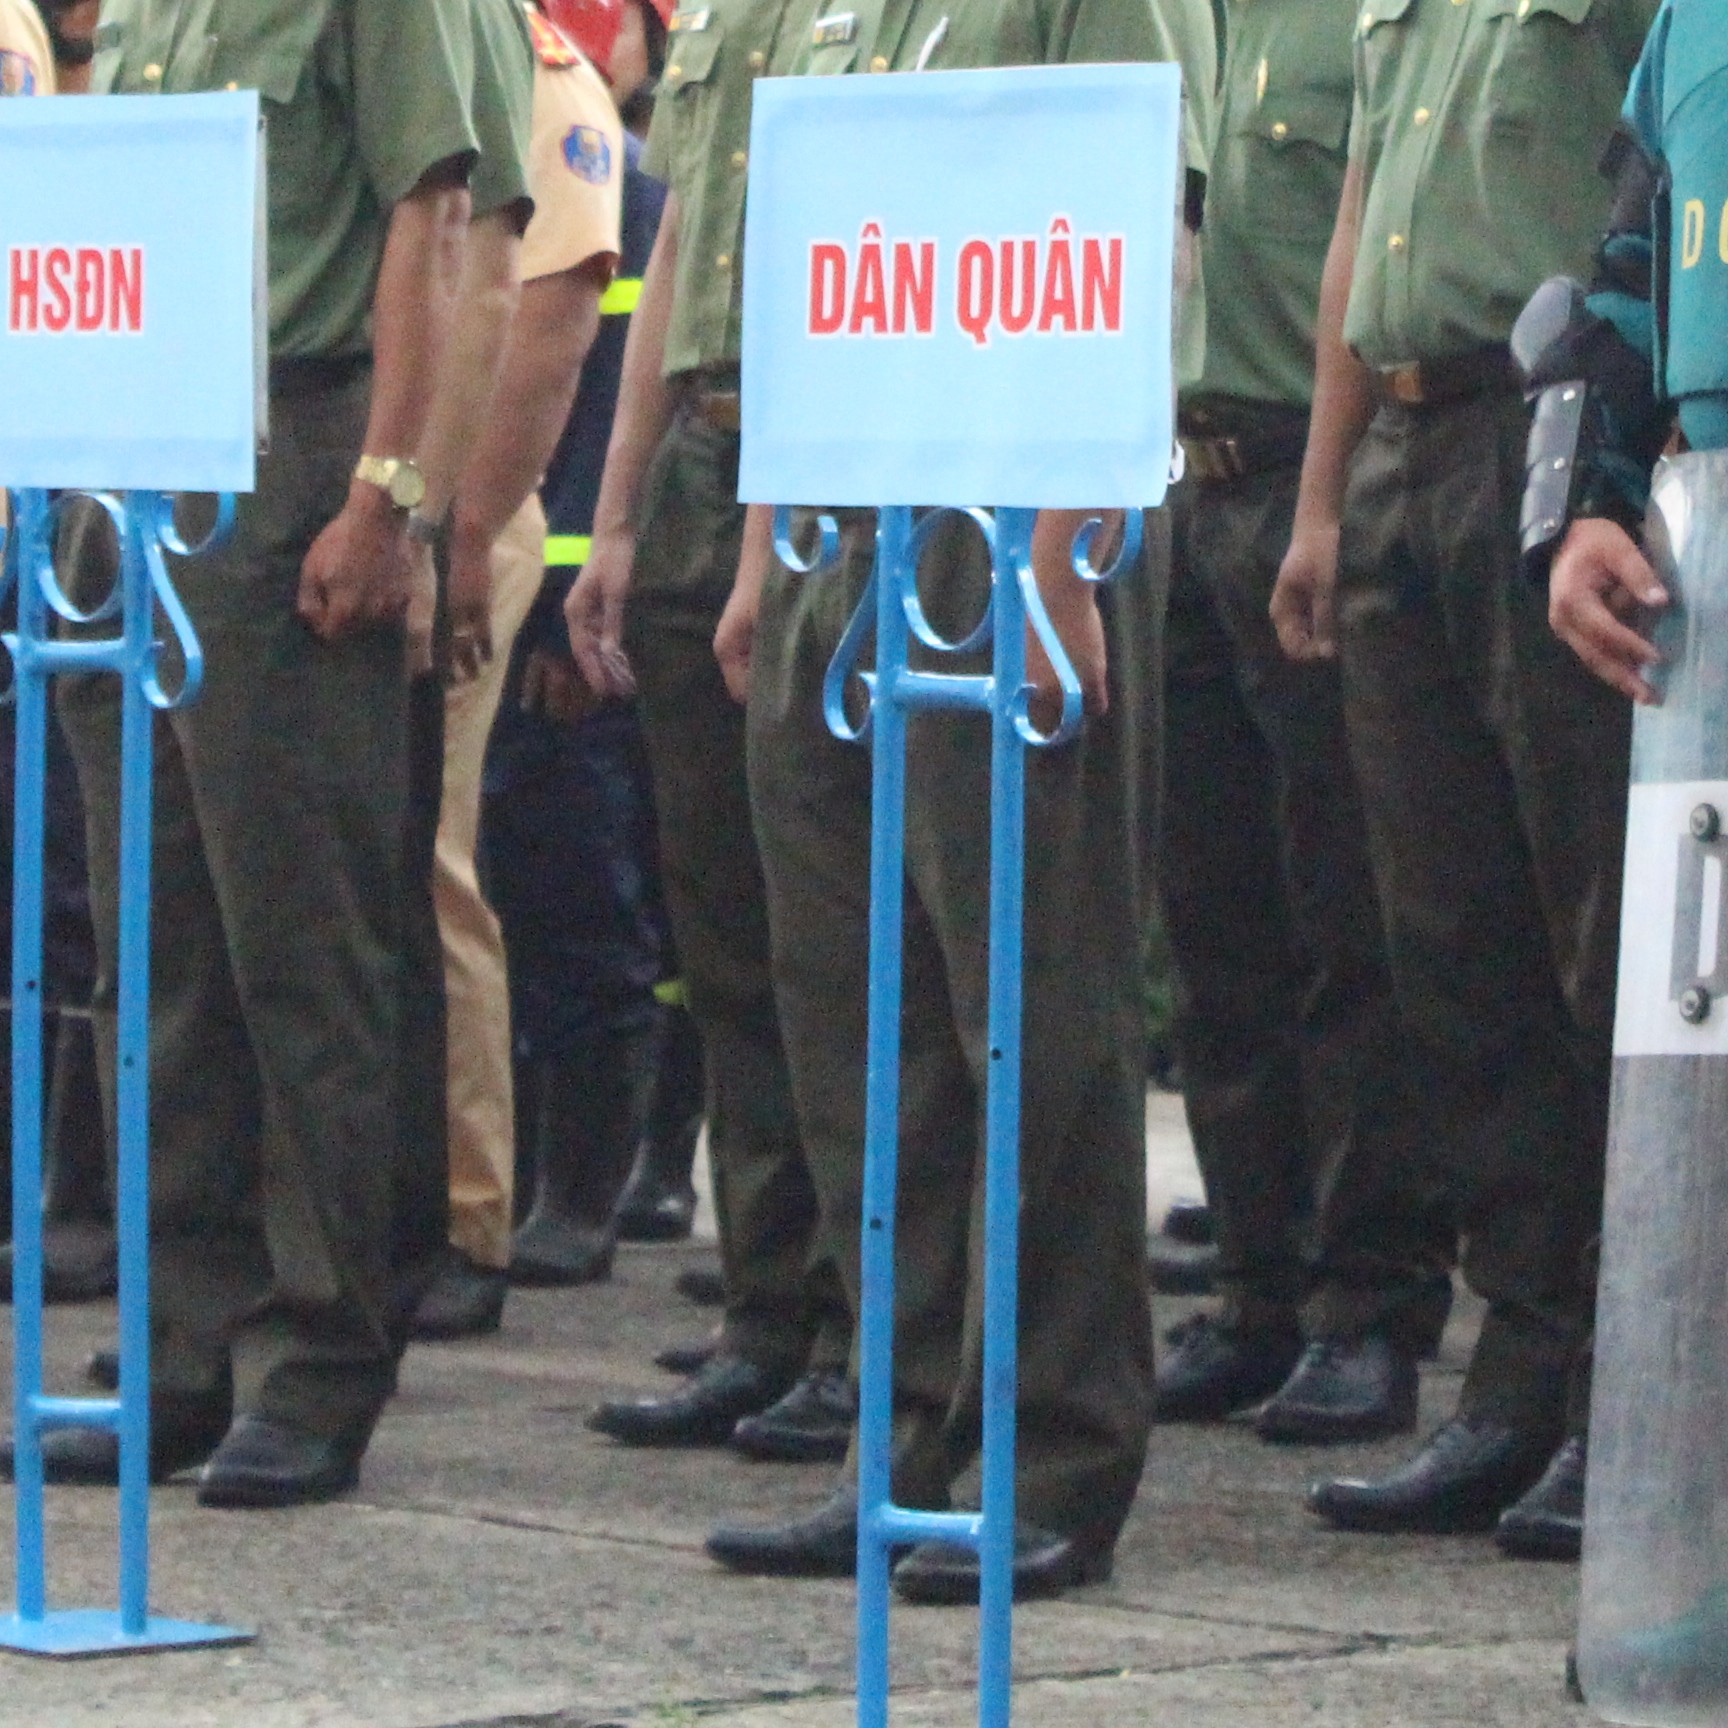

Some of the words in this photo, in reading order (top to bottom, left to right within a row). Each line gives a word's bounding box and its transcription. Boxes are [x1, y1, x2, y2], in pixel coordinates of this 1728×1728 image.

[9, 247, 143, 333] HSĐN
[809, 222, 935, 334] DÂN
[956, 217, 1122, 344] QUÂN
